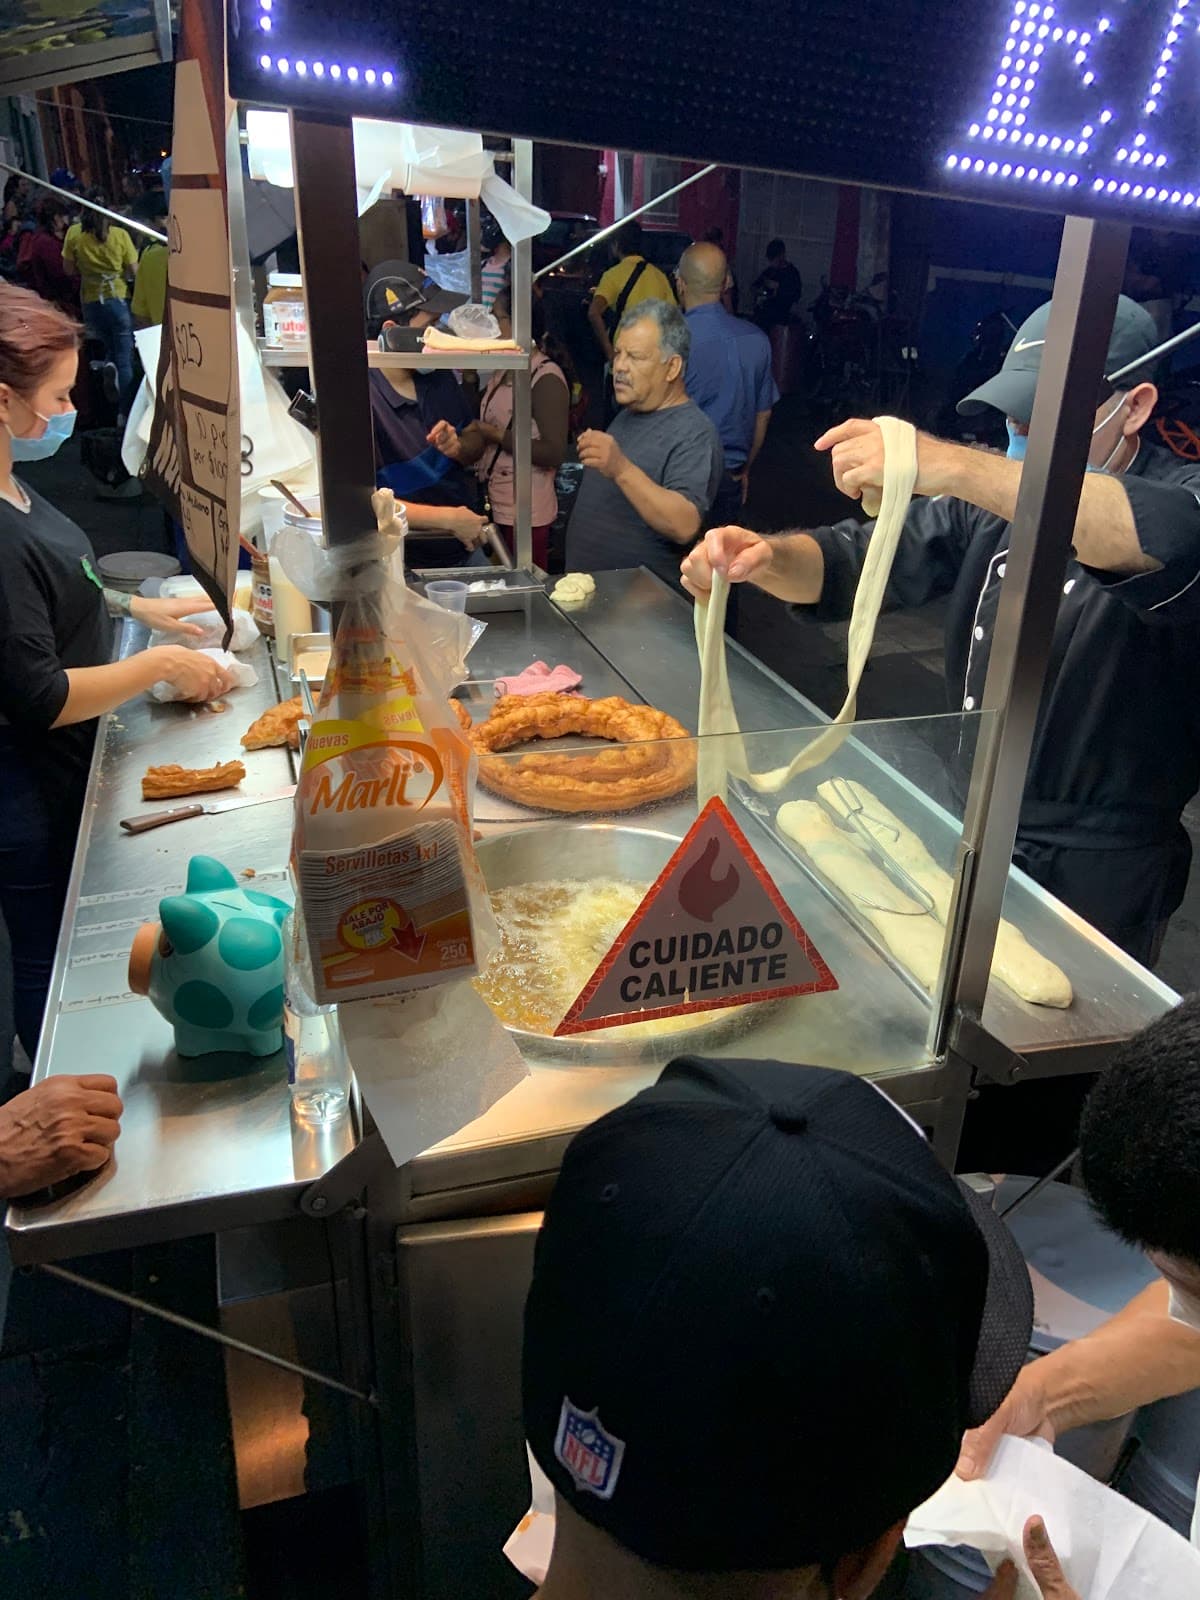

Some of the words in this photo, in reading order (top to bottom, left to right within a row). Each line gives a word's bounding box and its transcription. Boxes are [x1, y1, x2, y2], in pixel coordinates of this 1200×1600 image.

[309, 763, 415, 816] Marli
[325, 849, 410, 875] Servilletas
[351, 912, 385, 933] ABAJO
[368, 900, 390, 916] POR
[440, 942, 467, 961] 250
[628, 922, 783, 970] CUIDADO
[619, 953, 788, 1004] CALIENTE
[563, 1432, 606, 1487] NFL
